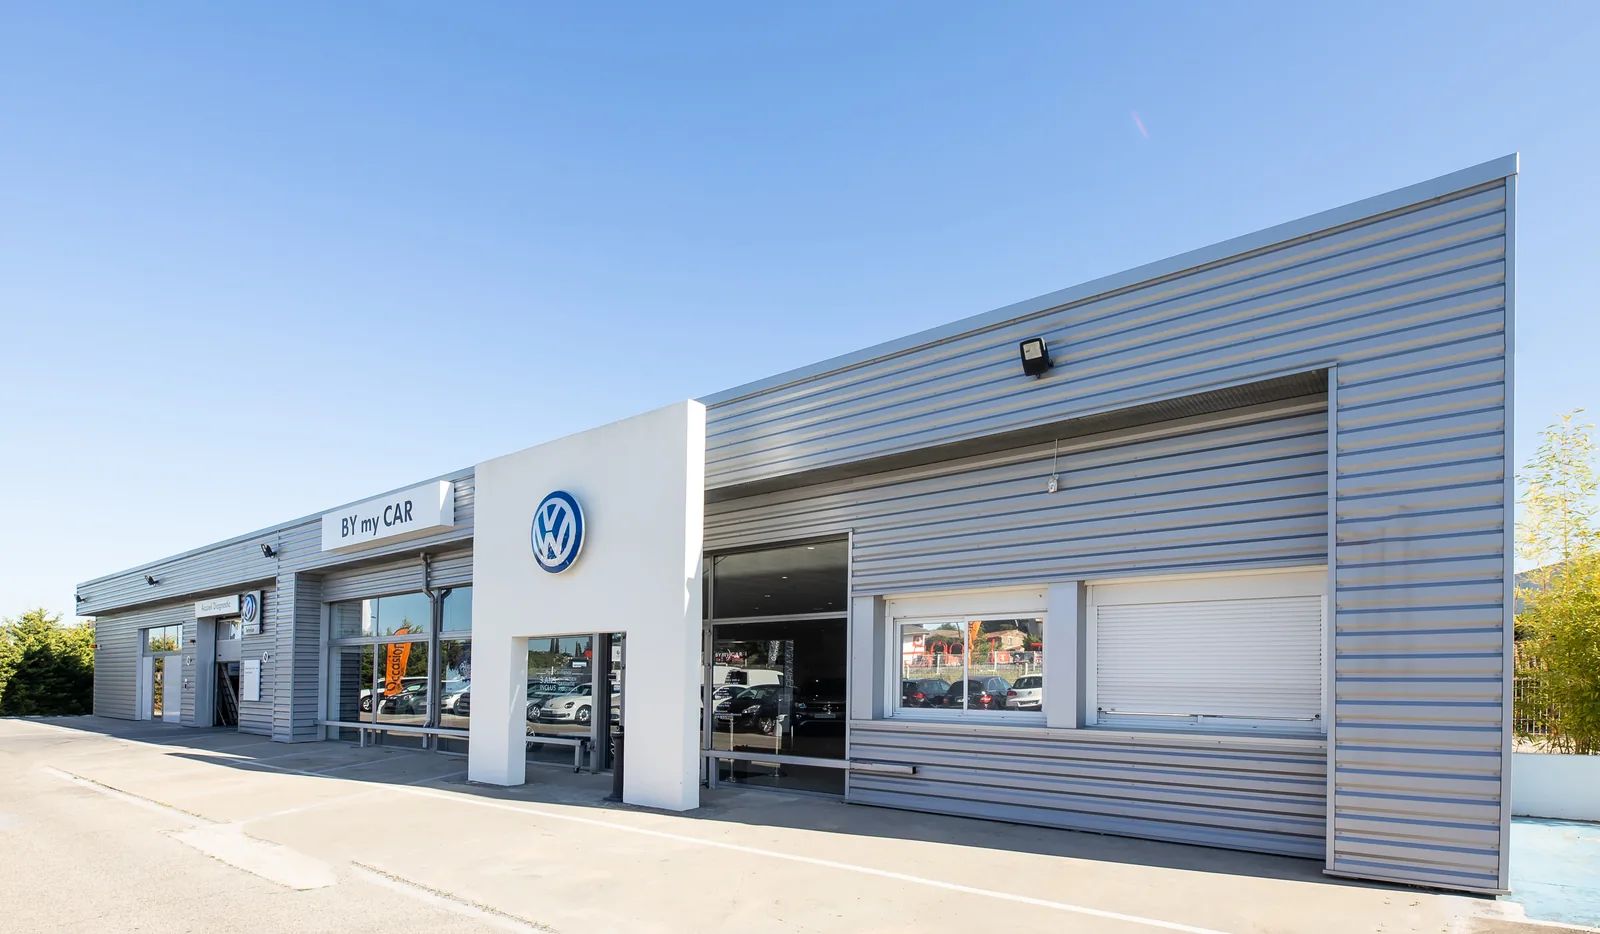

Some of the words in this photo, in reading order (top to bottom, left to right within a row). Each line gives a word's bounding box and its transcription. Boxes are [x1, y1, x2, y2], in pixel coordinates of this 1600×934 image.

[341, 514, 358, 538] BY
[361, 516, 380, 536] my
[383, 500, 413, 527] CAR
